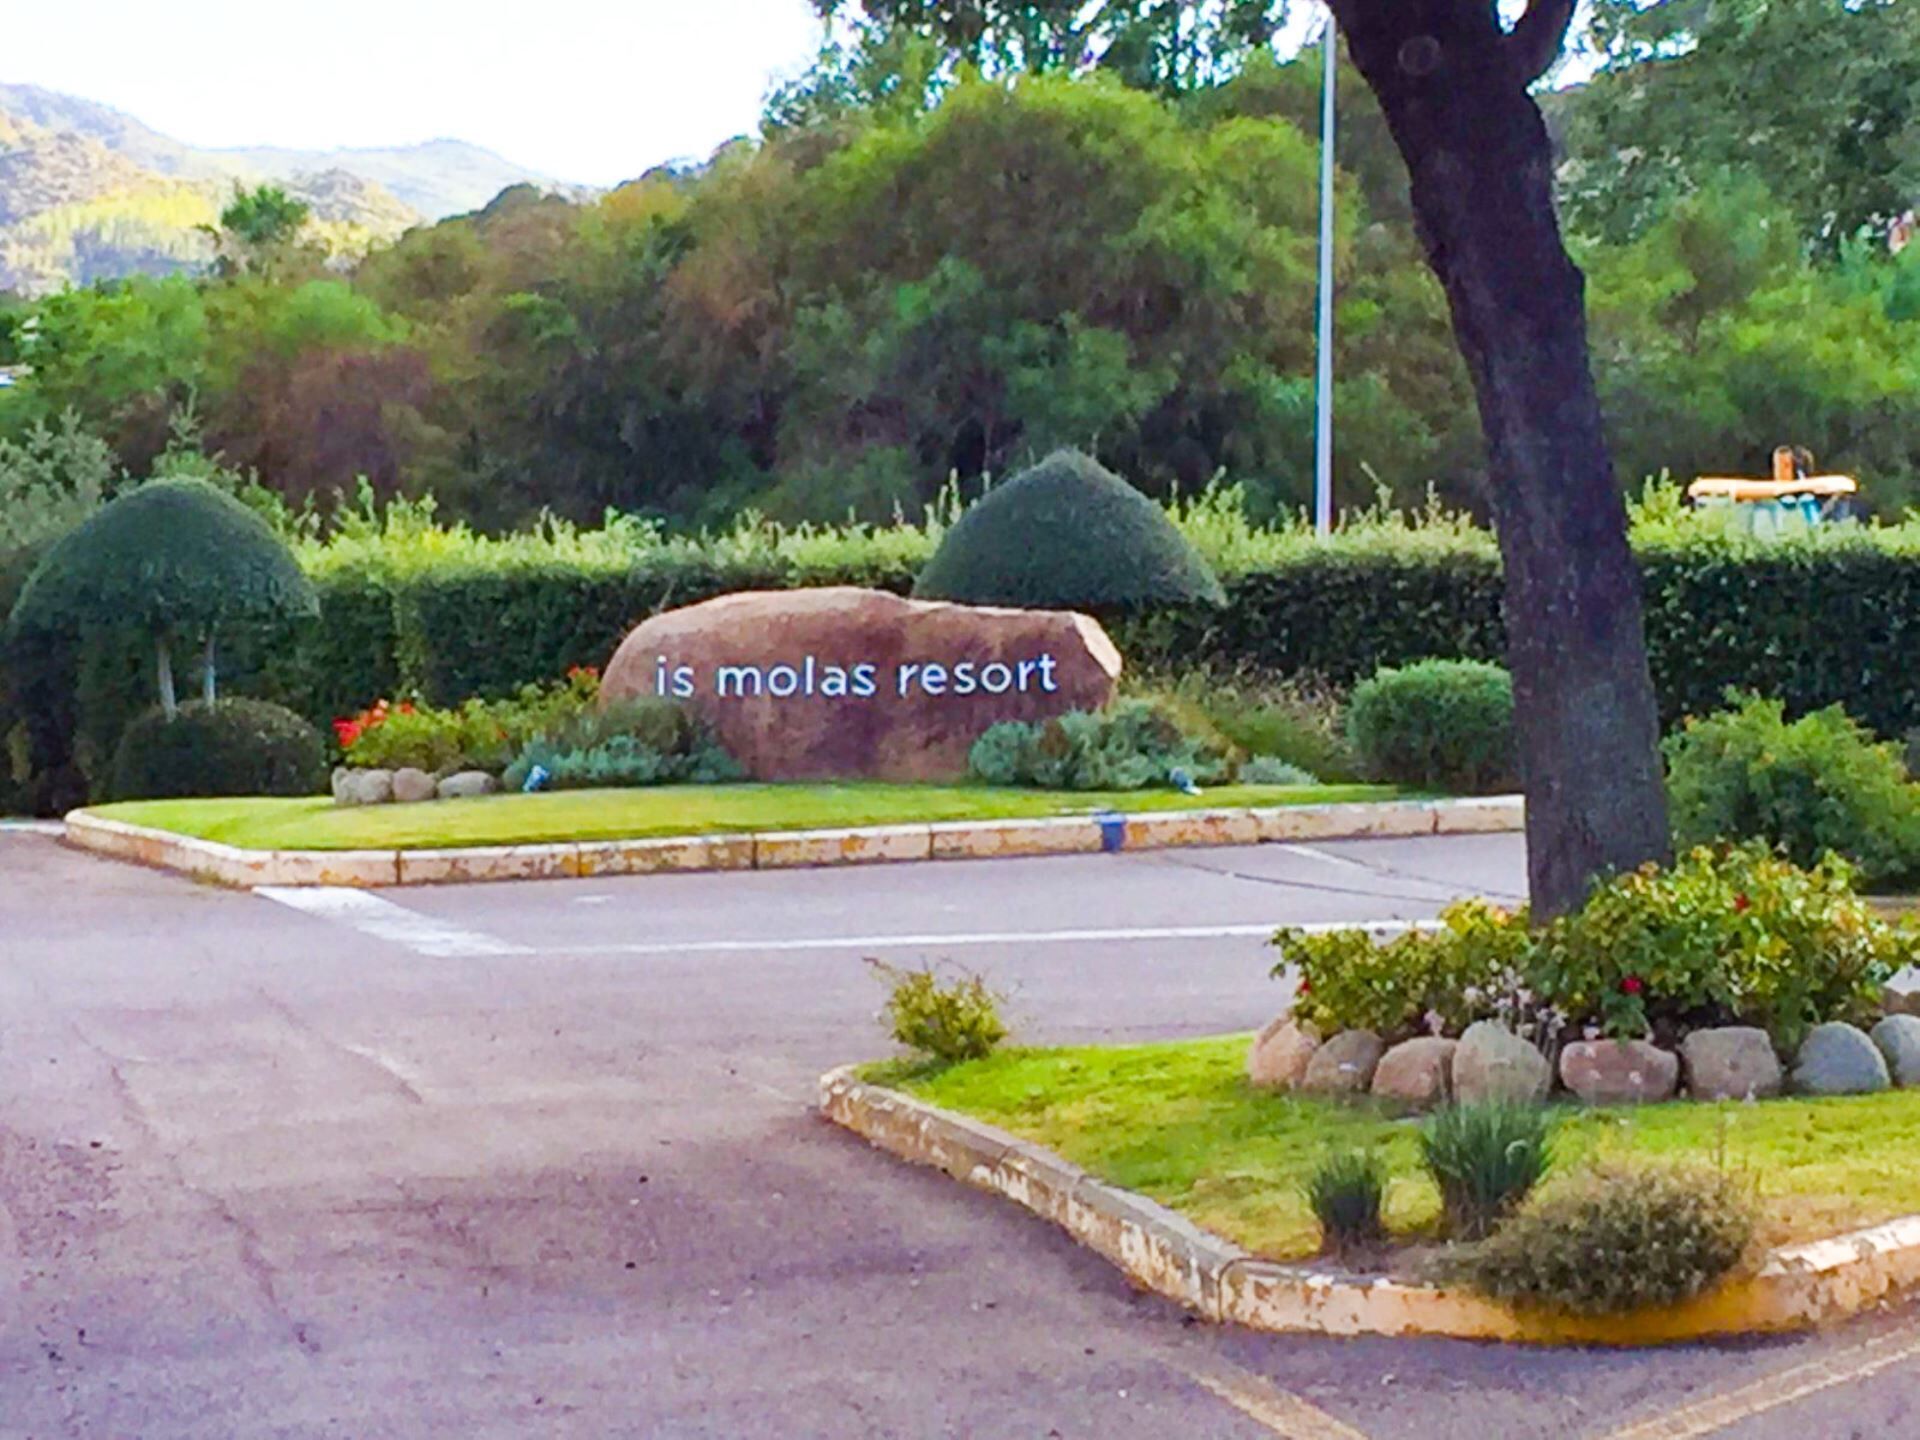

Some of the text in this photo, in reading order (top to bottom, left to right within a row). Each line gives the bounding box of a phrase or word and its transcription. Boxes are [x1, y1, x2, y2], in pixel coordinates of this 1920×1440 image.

[656, 652, 1058, 697] is molas resort
